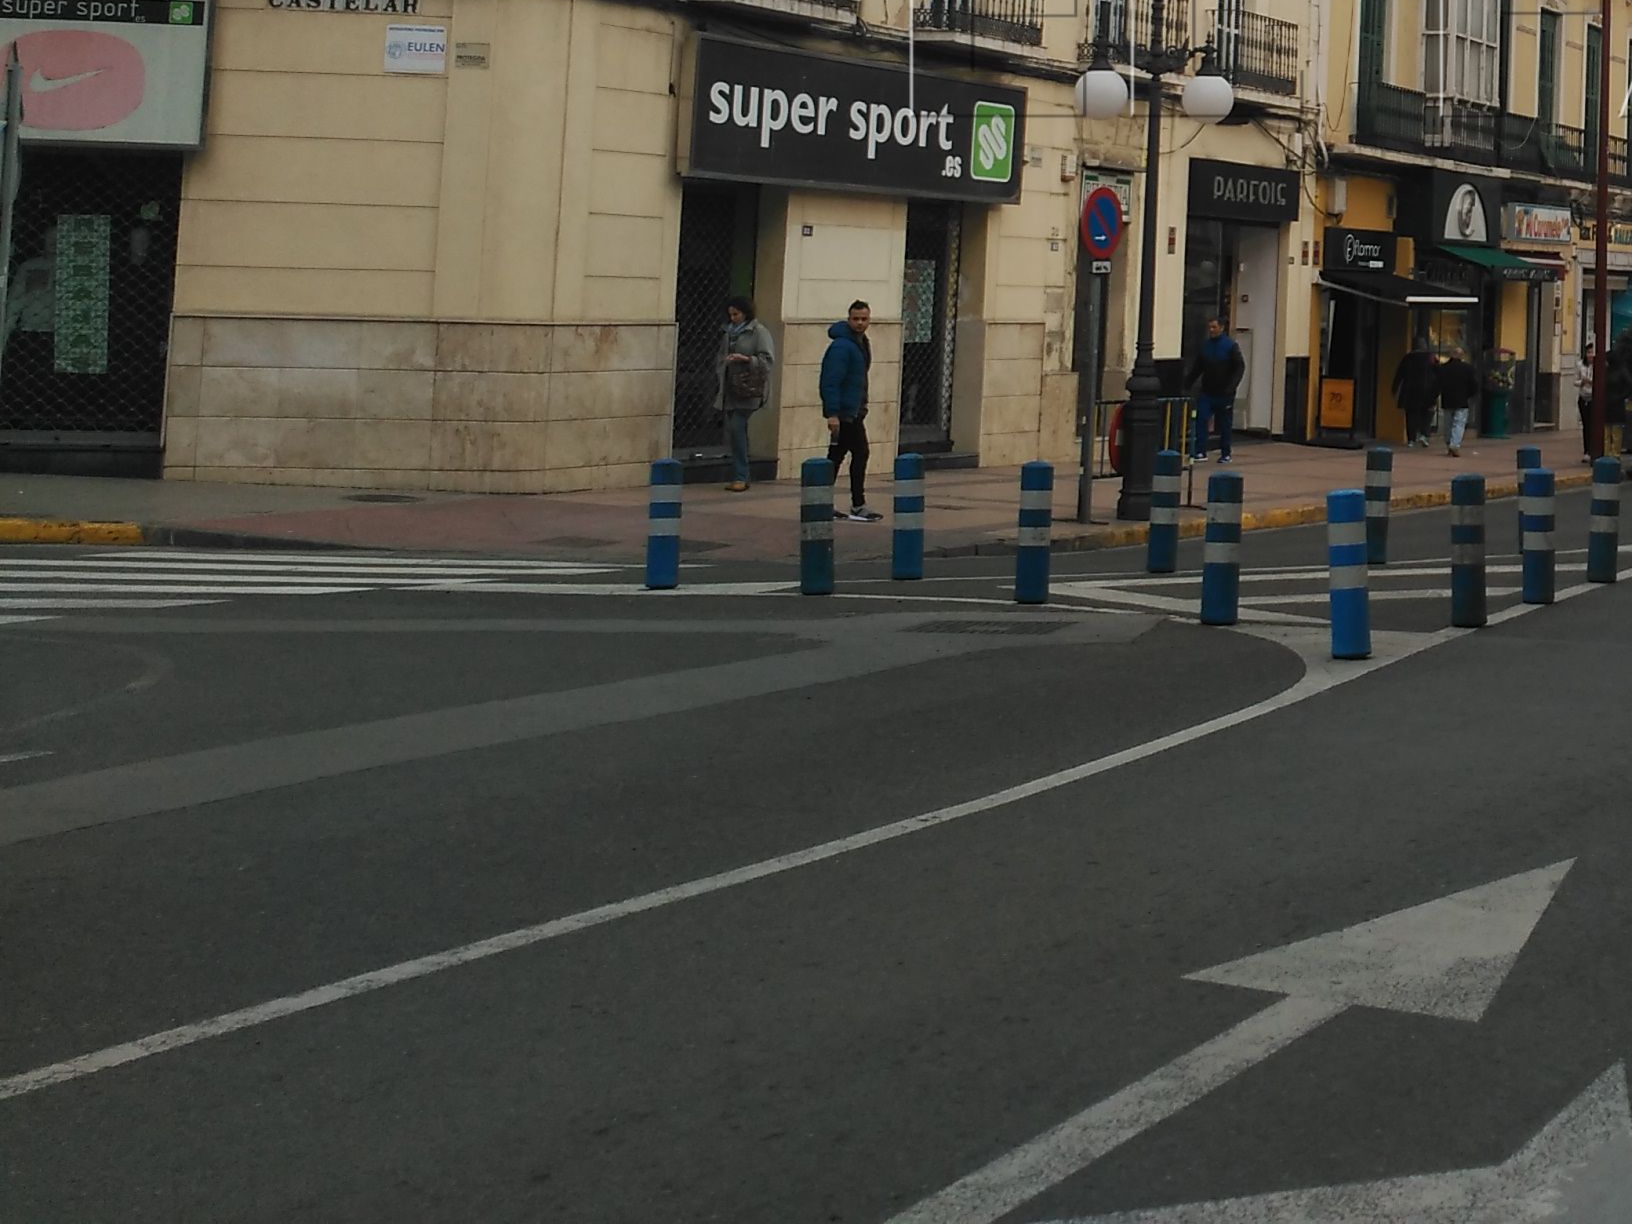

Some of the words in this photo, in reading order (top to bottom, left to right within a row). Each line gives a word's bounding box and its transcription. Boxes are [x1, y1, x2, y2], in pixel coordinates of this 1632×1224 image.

[2, 0, 67, 19] super
[76, 0, 139, 21] sport
[407, 42, 445, 53] EULEN
[708, 81, 838, 148] super
[849, 100, 954, 159] sport
[941, 154, 962, 178] .es
[1213, 176, 1287, 206] PARFOIS
